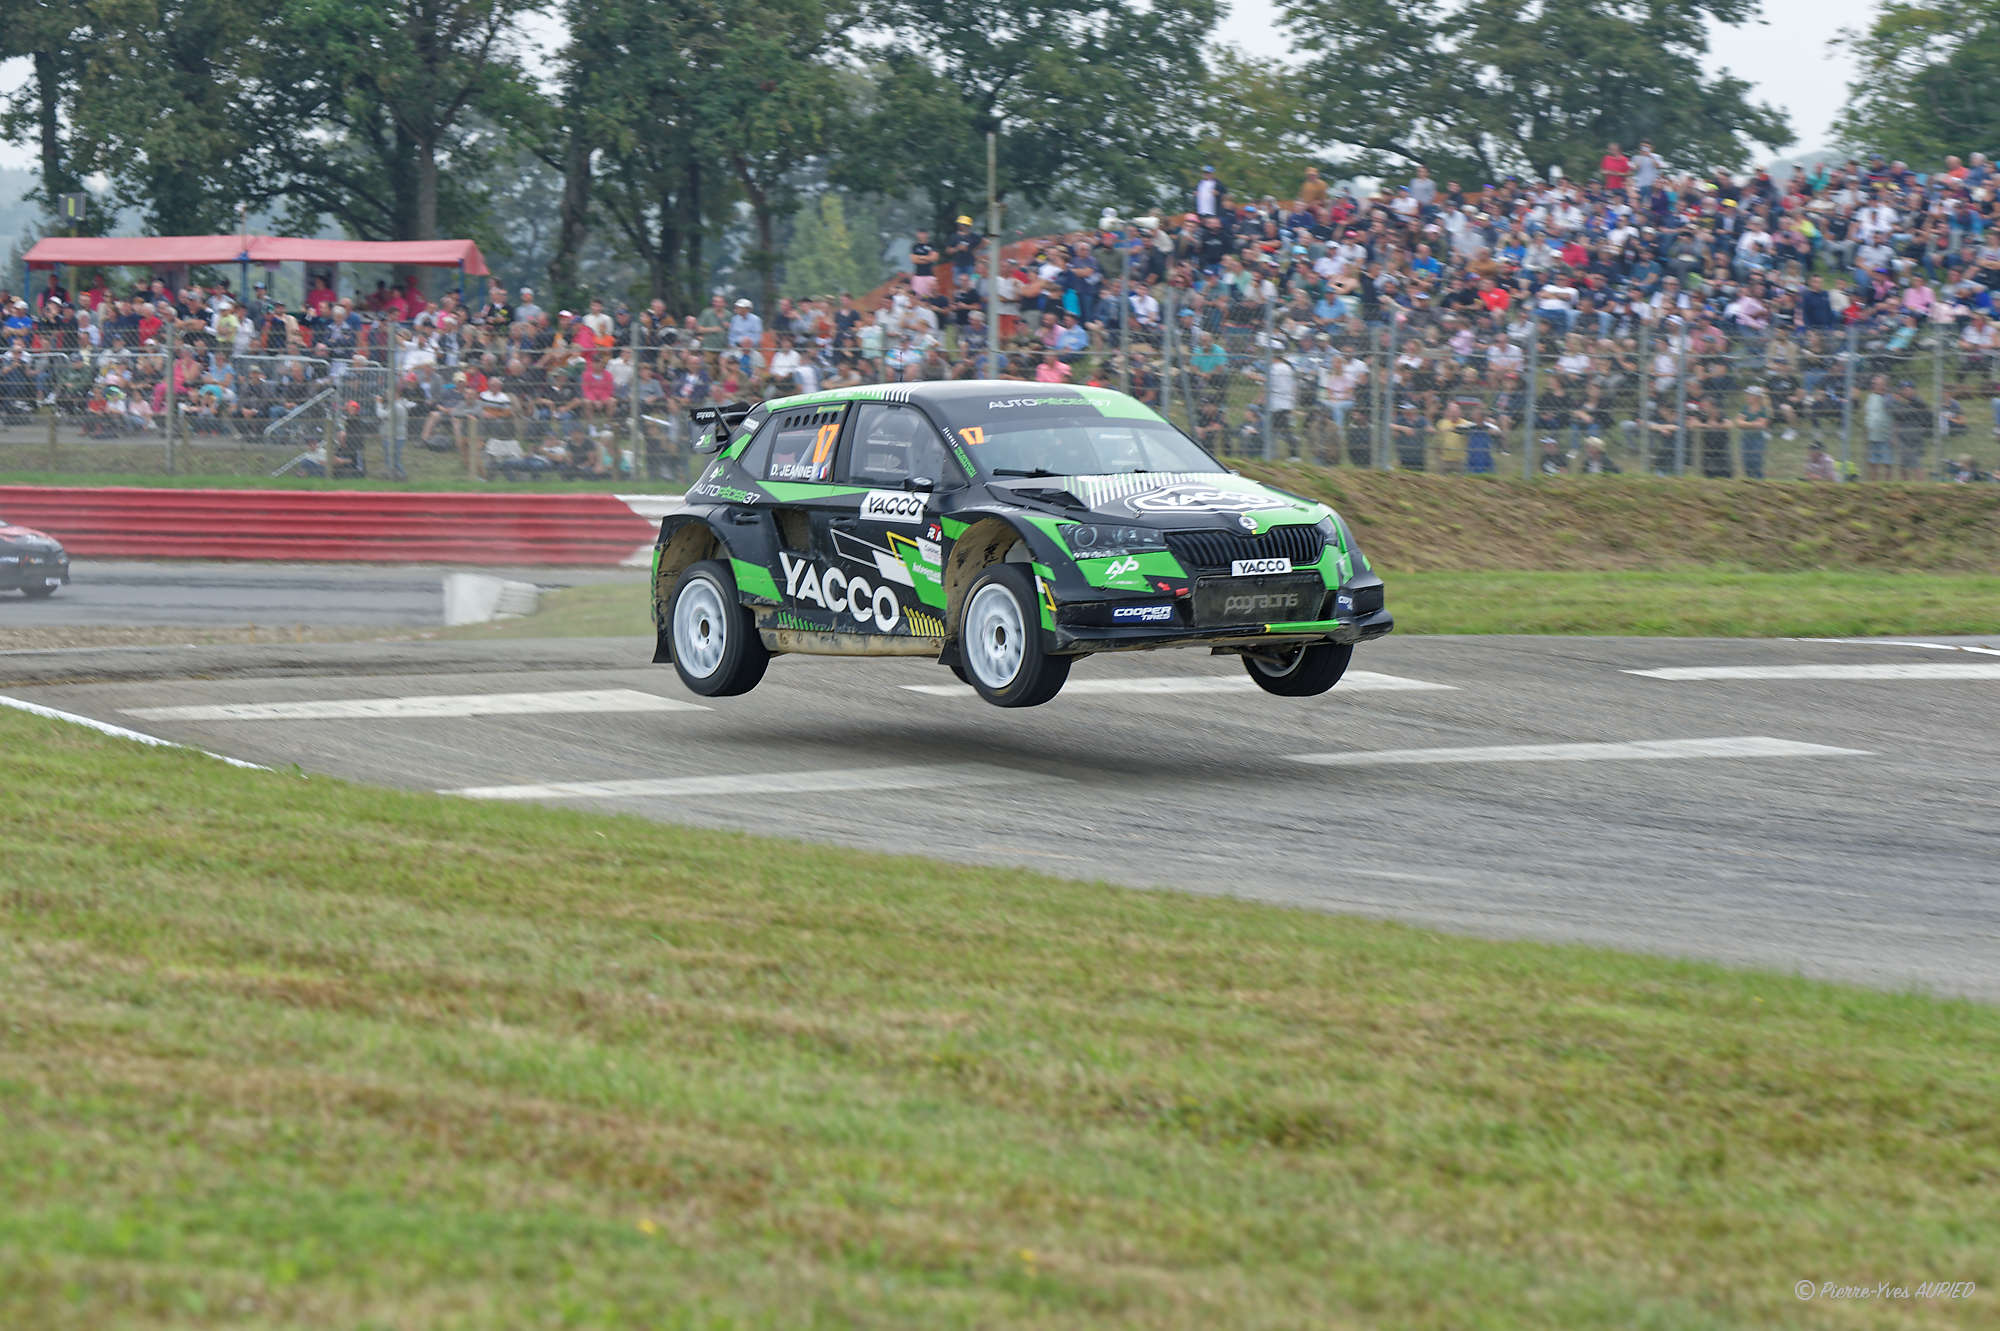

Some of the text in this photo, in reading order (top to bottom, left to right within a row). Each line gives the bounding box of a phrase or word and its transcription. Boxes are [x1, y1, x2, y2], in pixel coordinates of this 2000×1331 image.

[812, 424, 840, 463] 17
[959, 426, 984, 446] 17
[770, 463, 779, 476] D.
[869, 497, 921, 516] YACCO
[1238, 560, 1285, 573] YACCO
[779, 551, 899, 632] YACCO
[1113, 606, 1172, 617] COOPER
